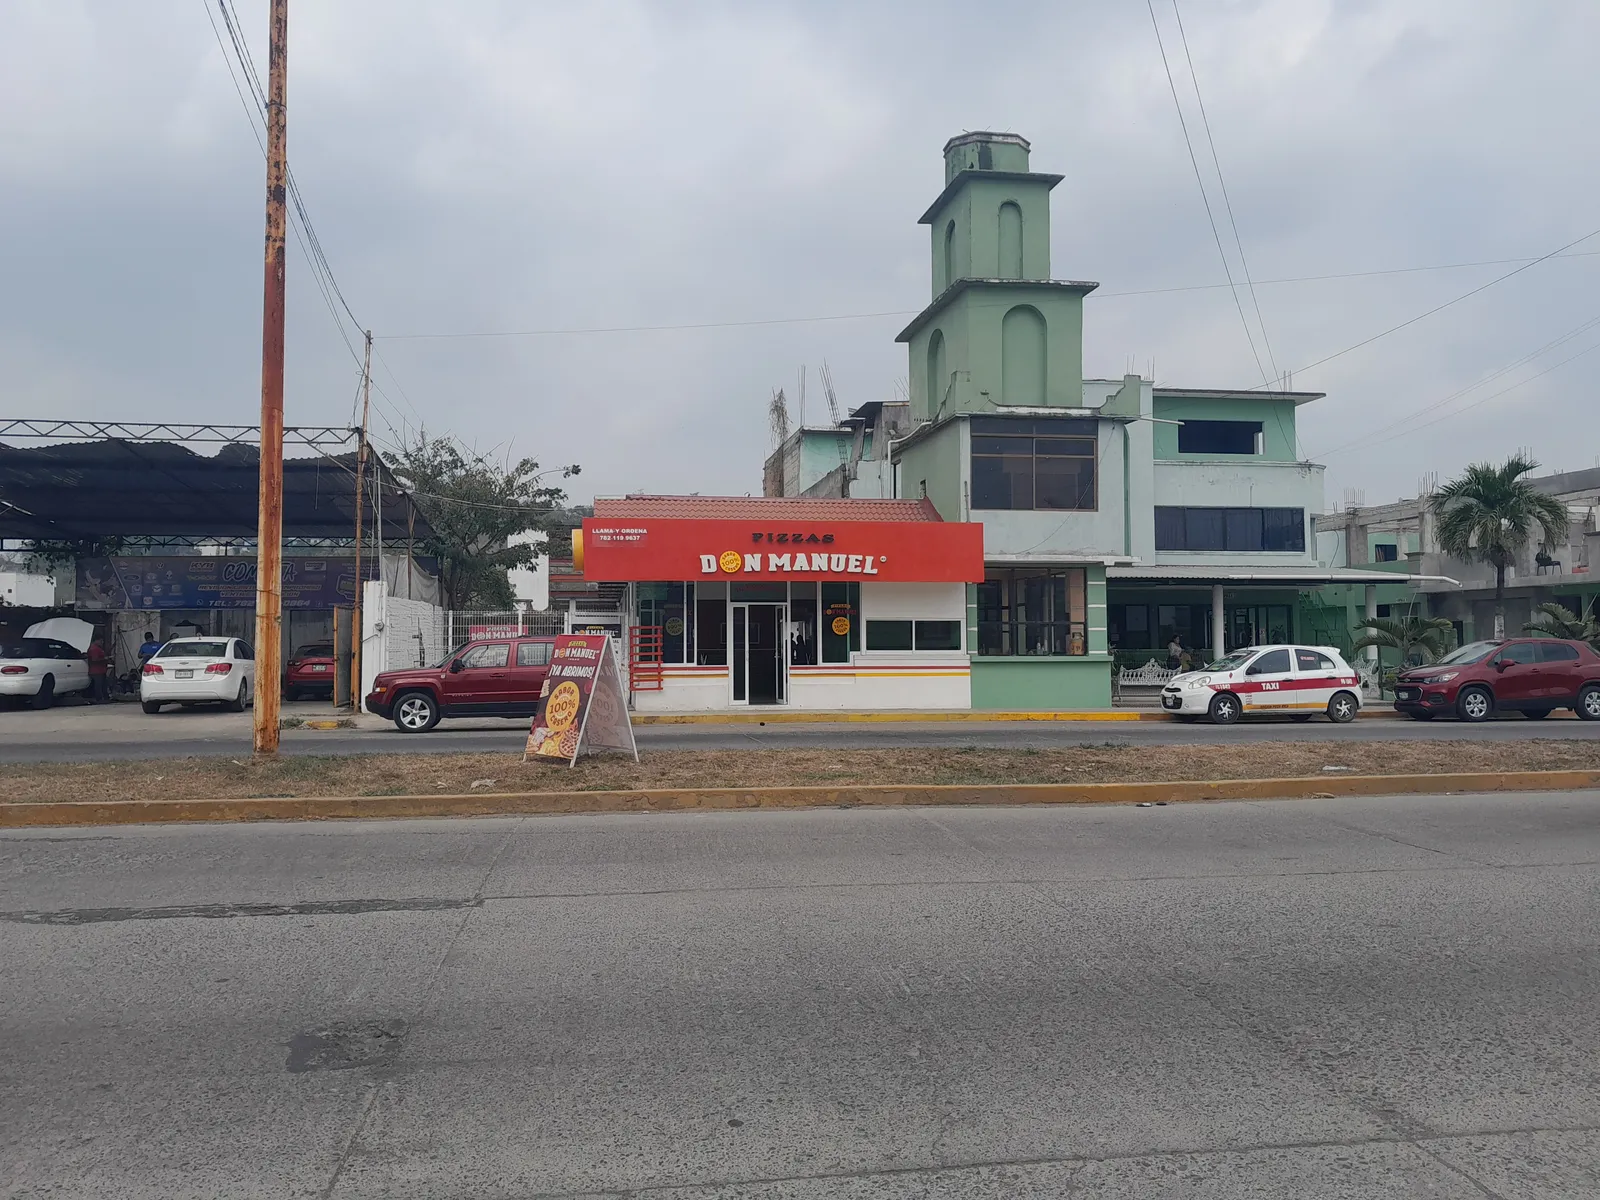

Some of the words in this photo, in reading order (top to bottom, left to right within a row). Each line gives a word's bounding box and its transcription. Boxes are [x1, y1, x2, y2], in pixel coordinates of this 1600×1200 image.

[752, 533, 834, 543] PIZZAS
[768, 553, 878, 574] MANUEL
[570, 648, 596, 660] MANUEL
[548, 664, 561, 677] ¡YA
[560, 665, 596, 679] ABRIMOS!
[554, 686, 575, 701] SABOR
[549, 699, 576, 714] 100%
[550, 711, 573, 727] CASERO
